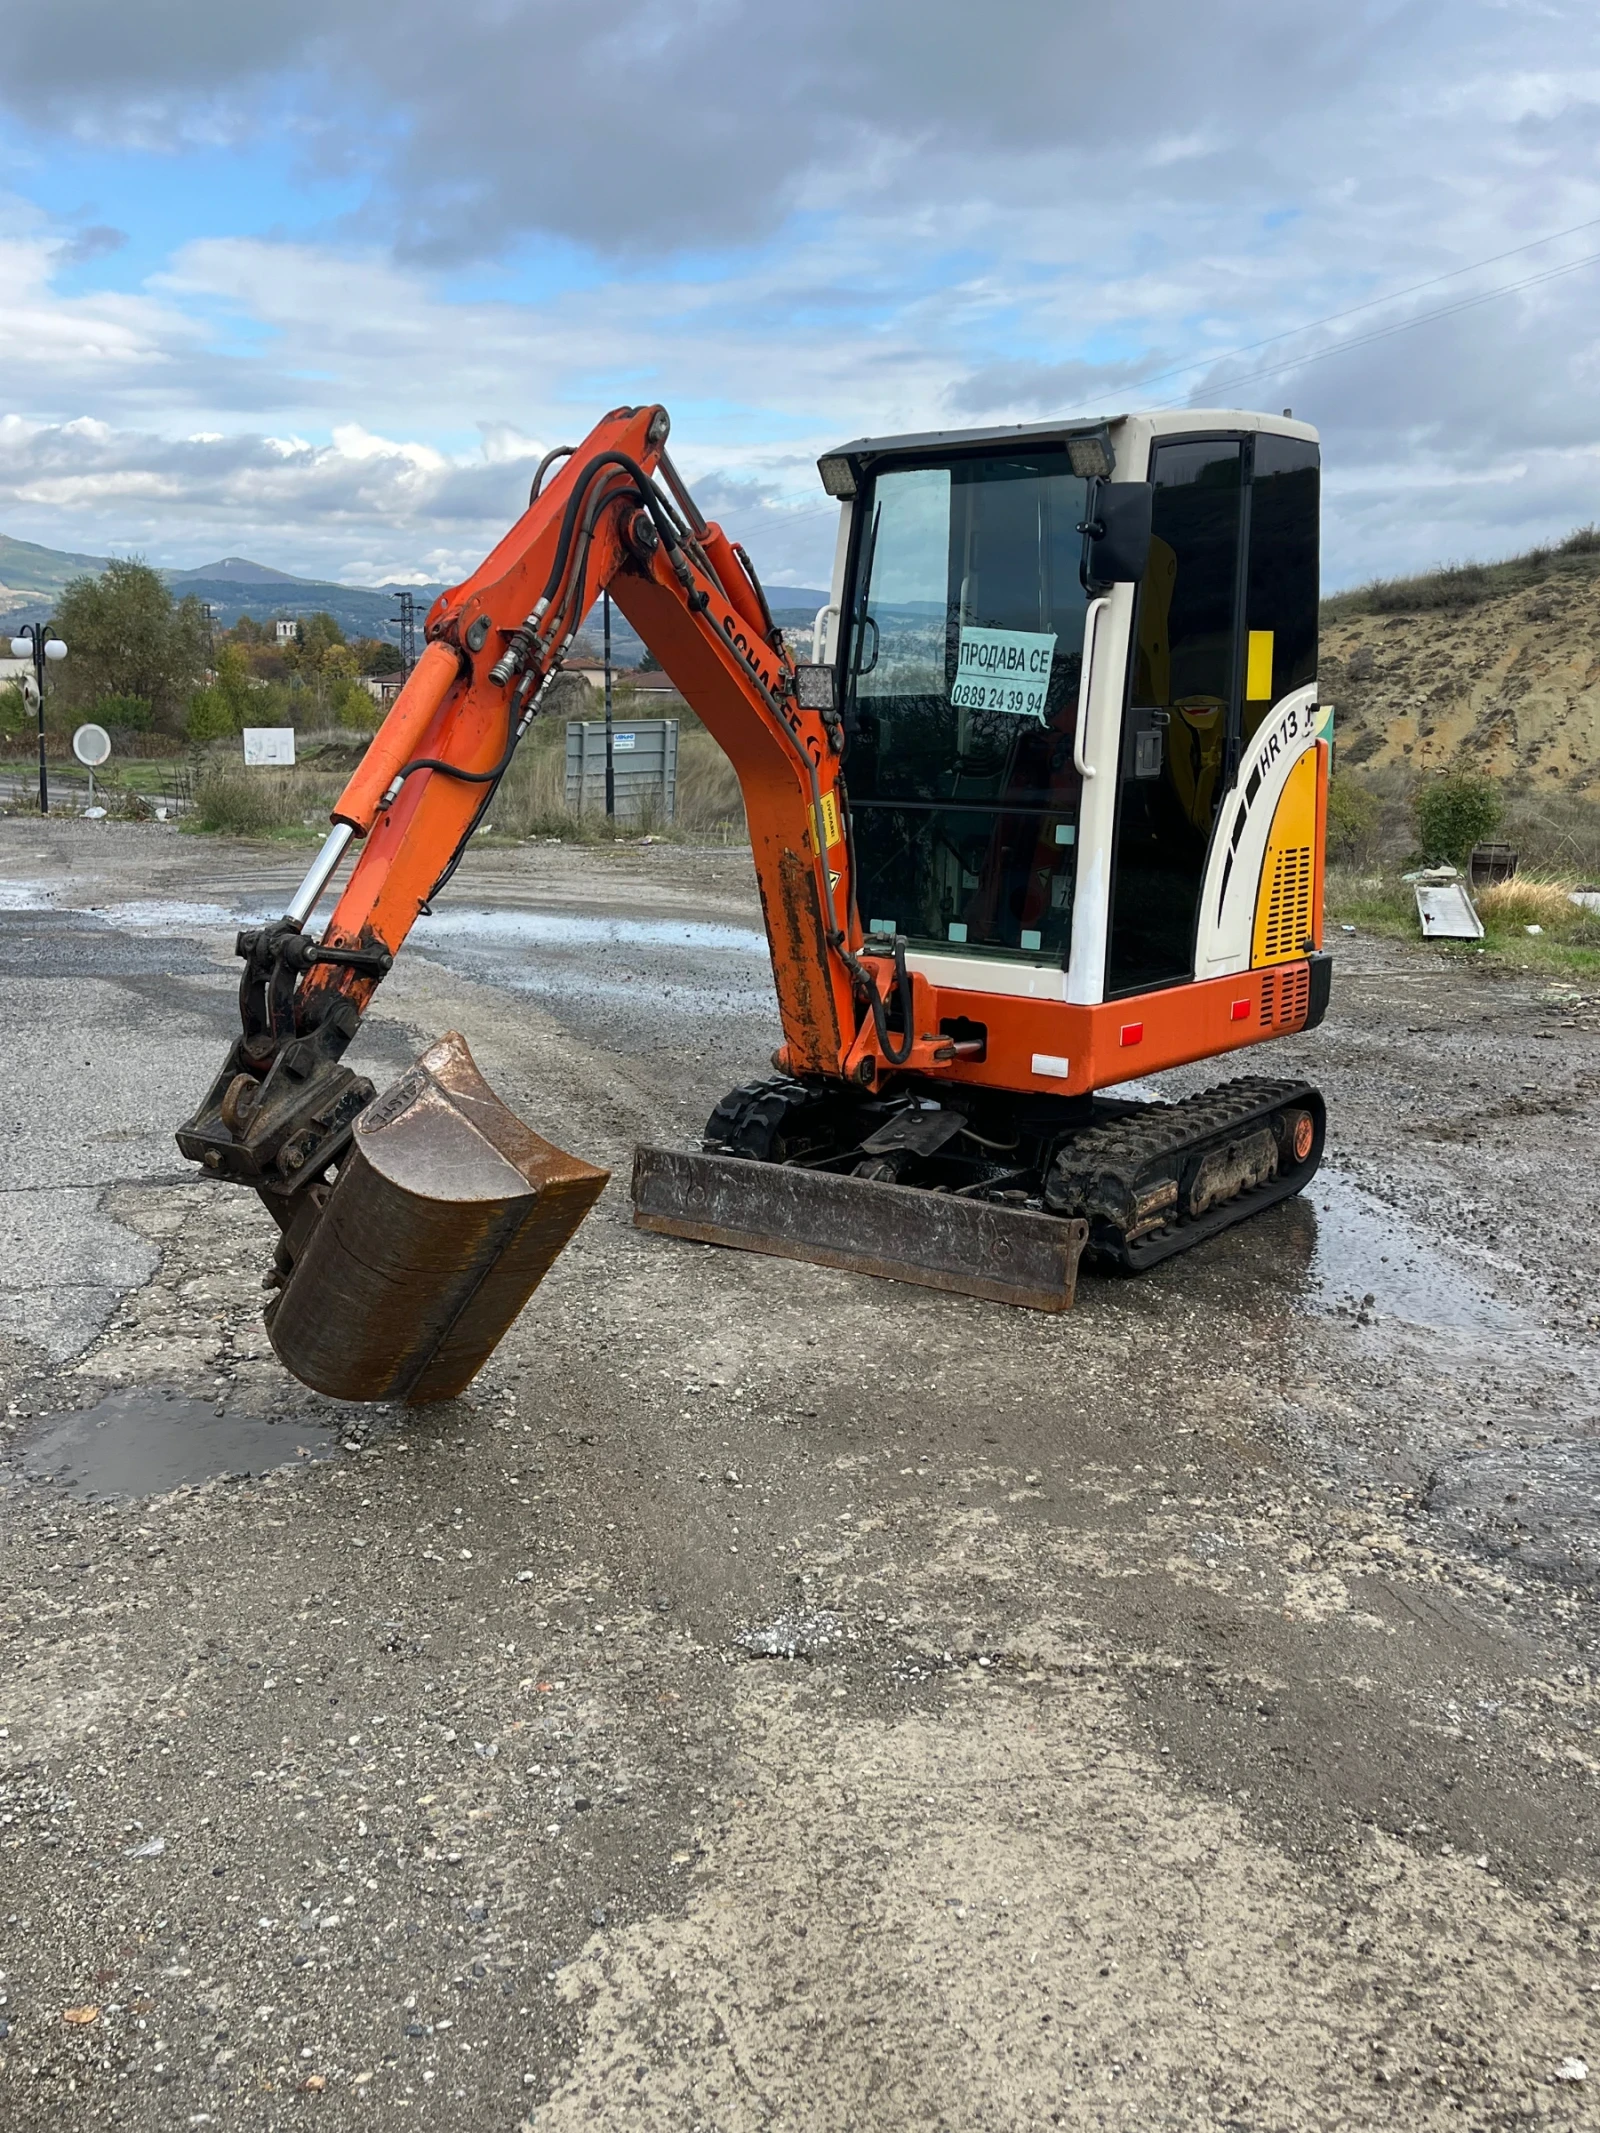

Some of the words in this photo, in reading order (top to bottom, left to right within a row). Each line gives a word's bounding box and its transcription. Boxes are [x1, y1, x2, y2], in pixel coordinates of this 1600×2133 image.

[960, 642, 1025, 673] ПРОДАВА
[1029, 649, 1050, 674] СЕ
[953, 684, 986, 708] 0889
[988, 688, 1004, 709] 24
[1007, 691, 1024, 712] 39
[1026, 692, 1043, 713] 94
[1259, 733, 1281, 778] HR
[1280, 710, 1298, 745] 13
